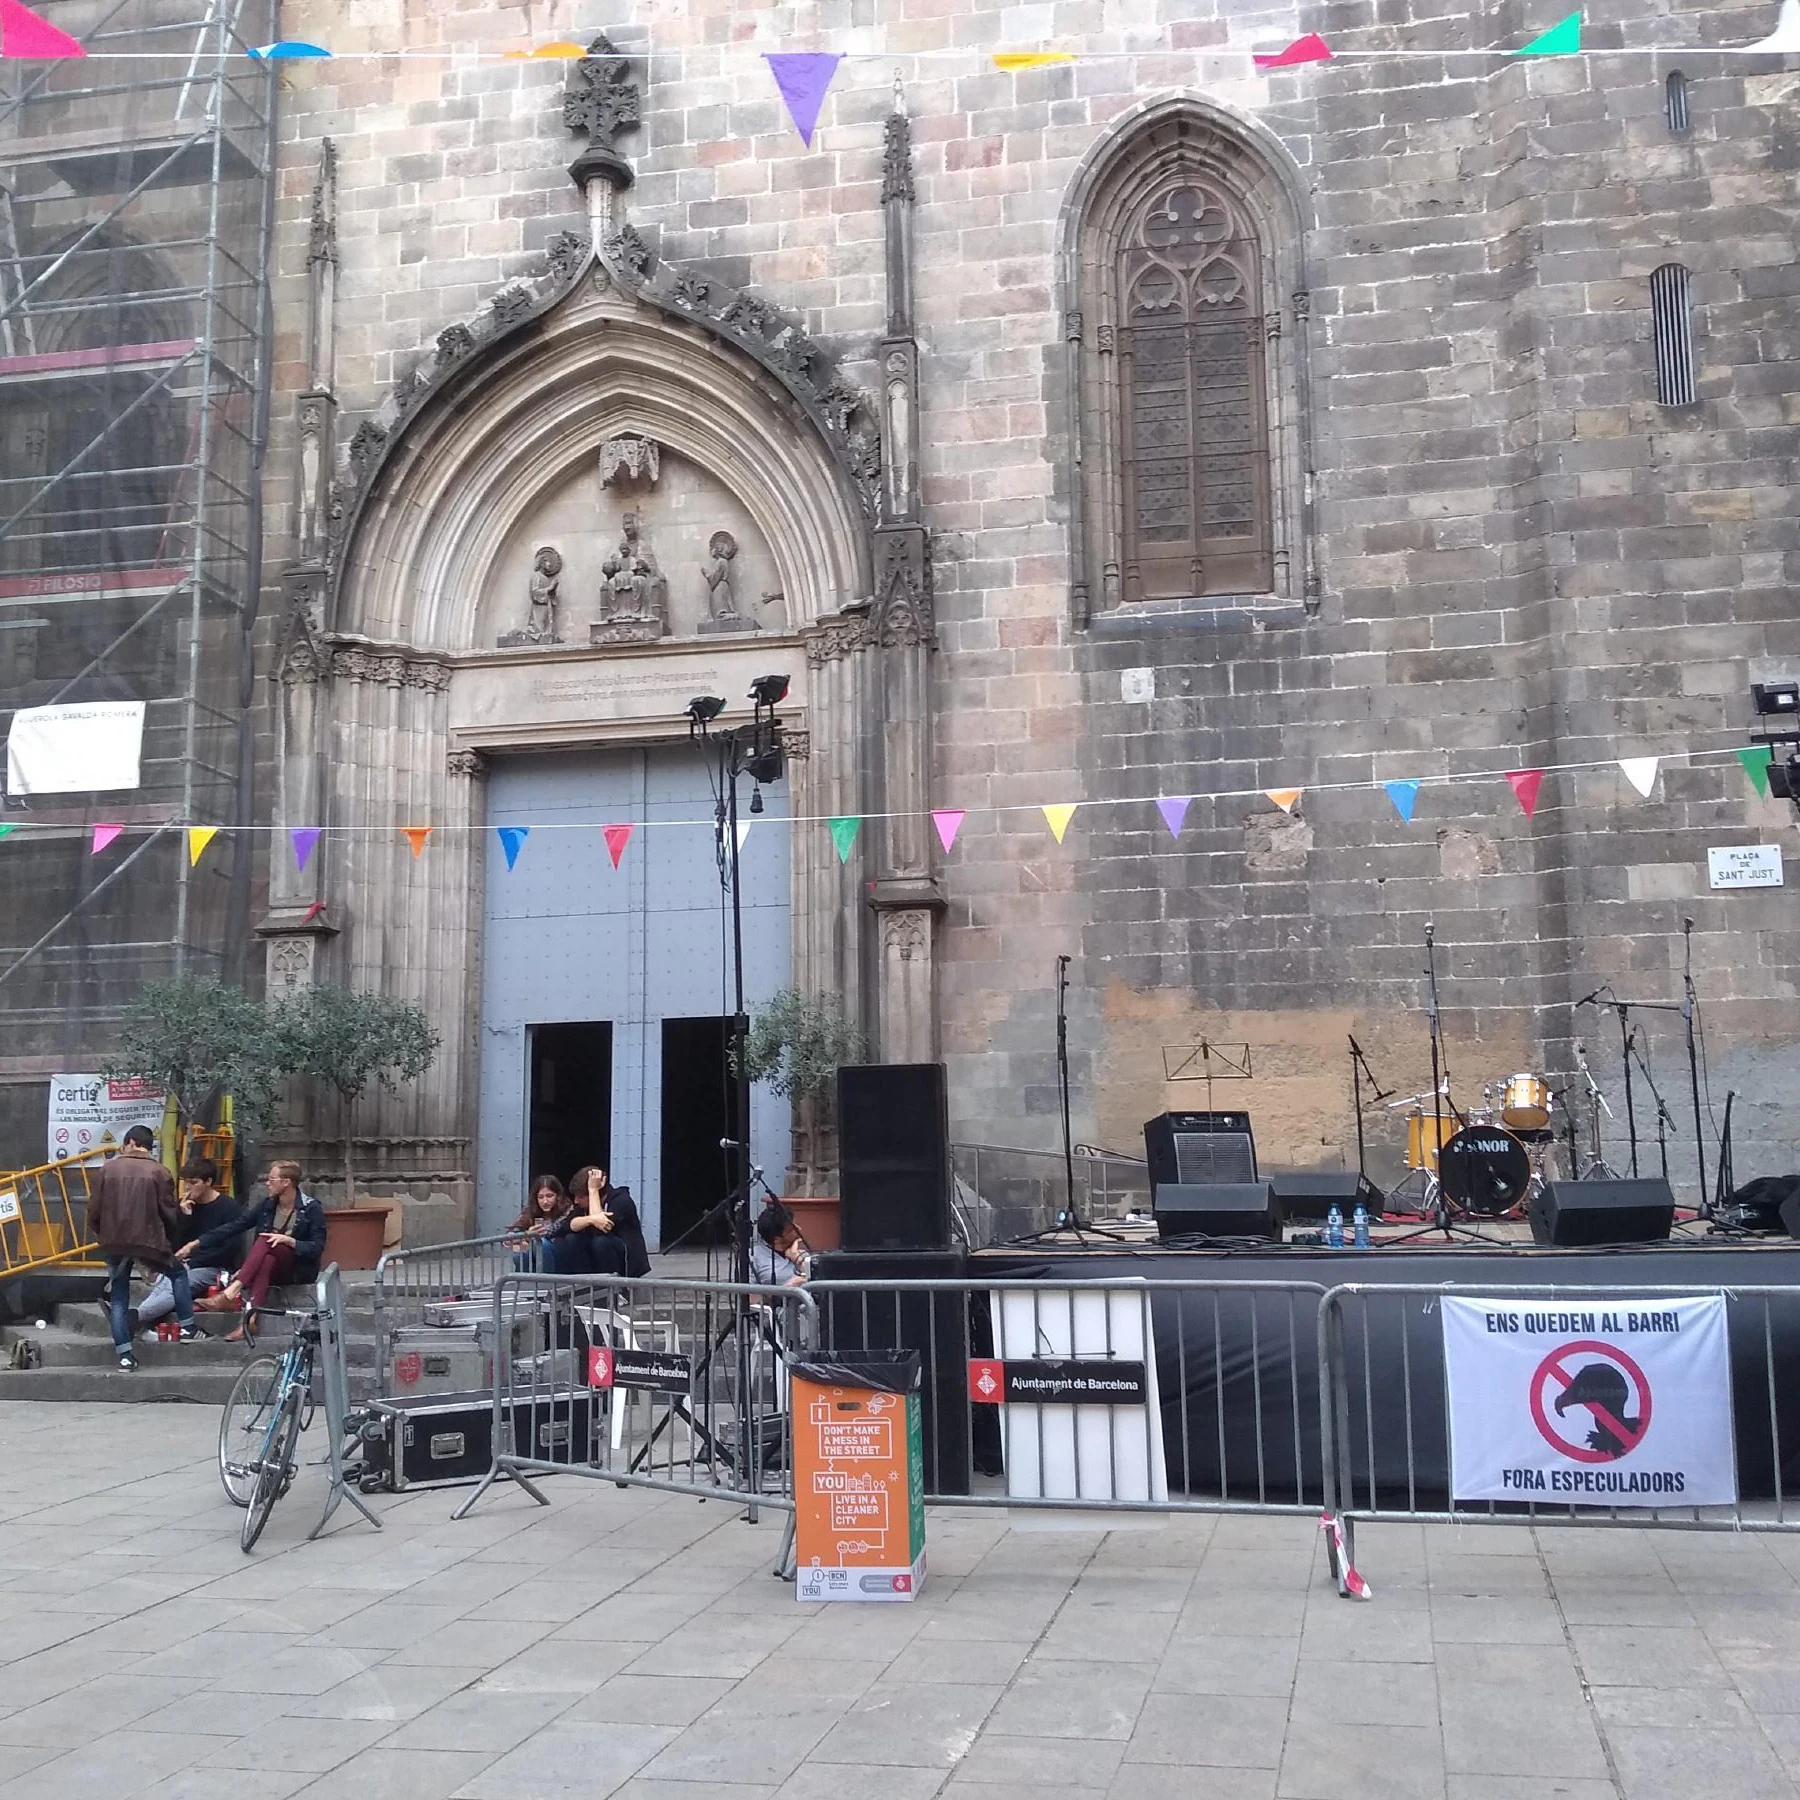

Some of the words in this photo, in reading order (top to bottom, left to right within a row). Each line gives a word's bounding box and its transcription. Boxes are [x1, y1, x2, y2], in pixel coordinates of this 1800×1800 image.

[1718, 870, 1744, 880] SANT
[1749, 869, 1774, 879] JUST
[58, 1082, 97, 1101] certis
[65, 1107, 107, 1115] OBLIGATRI
[109, 1105, 139, 1114] SEGUIR
[115, 1112, 160, 1121] SEGURETAT
[1486, 1313, 1519, 1333] ENS
[1525, 1312, 1595, 1334] QUEDEM
[1601, 1312, 1623, 1333] AL
[1628, 1312, 1680, 1332] BARRI
[615, 1362, 650, 1374] Ajuntament
[650, 1367, 659, 1376] de
[659, 1366, 688, 1378] Barcelona
[1011, 1376, 1072, 1390] Ajuntament
[1073, 1378, 1087, 1389] de
[1088, 1378, 1139, 1391] Barcelona
[823, 1426, 852, 1435] DON'T
[853, 1426, 881, 1435] MAKE
[823, 1436, 831, 1445] A
[832, 1436, 858, 1445] MESS
[860, 1436, 870, 1445] IN
[824, 1446, 843, 1455] THE
[844, 1446, 881, 1455] STREET
[816, 1476, 844, 1489] YOU
[1503, 1469, 1546, 1490] FORA
[1551, 1470, 1685, 1492] ESPECULADORS
[835, 1495, 856, 1504] LIVE
[858, 1495, 869, 1504] IN
[869, 1495, 877, 1504] A
[835, 1505, 879, 1515] CLEANER
[835, 1516, 857, 1525] CITY
[831, 1572, 845, 1580] BCN
[804, 1587, 819, 1595] YOU
